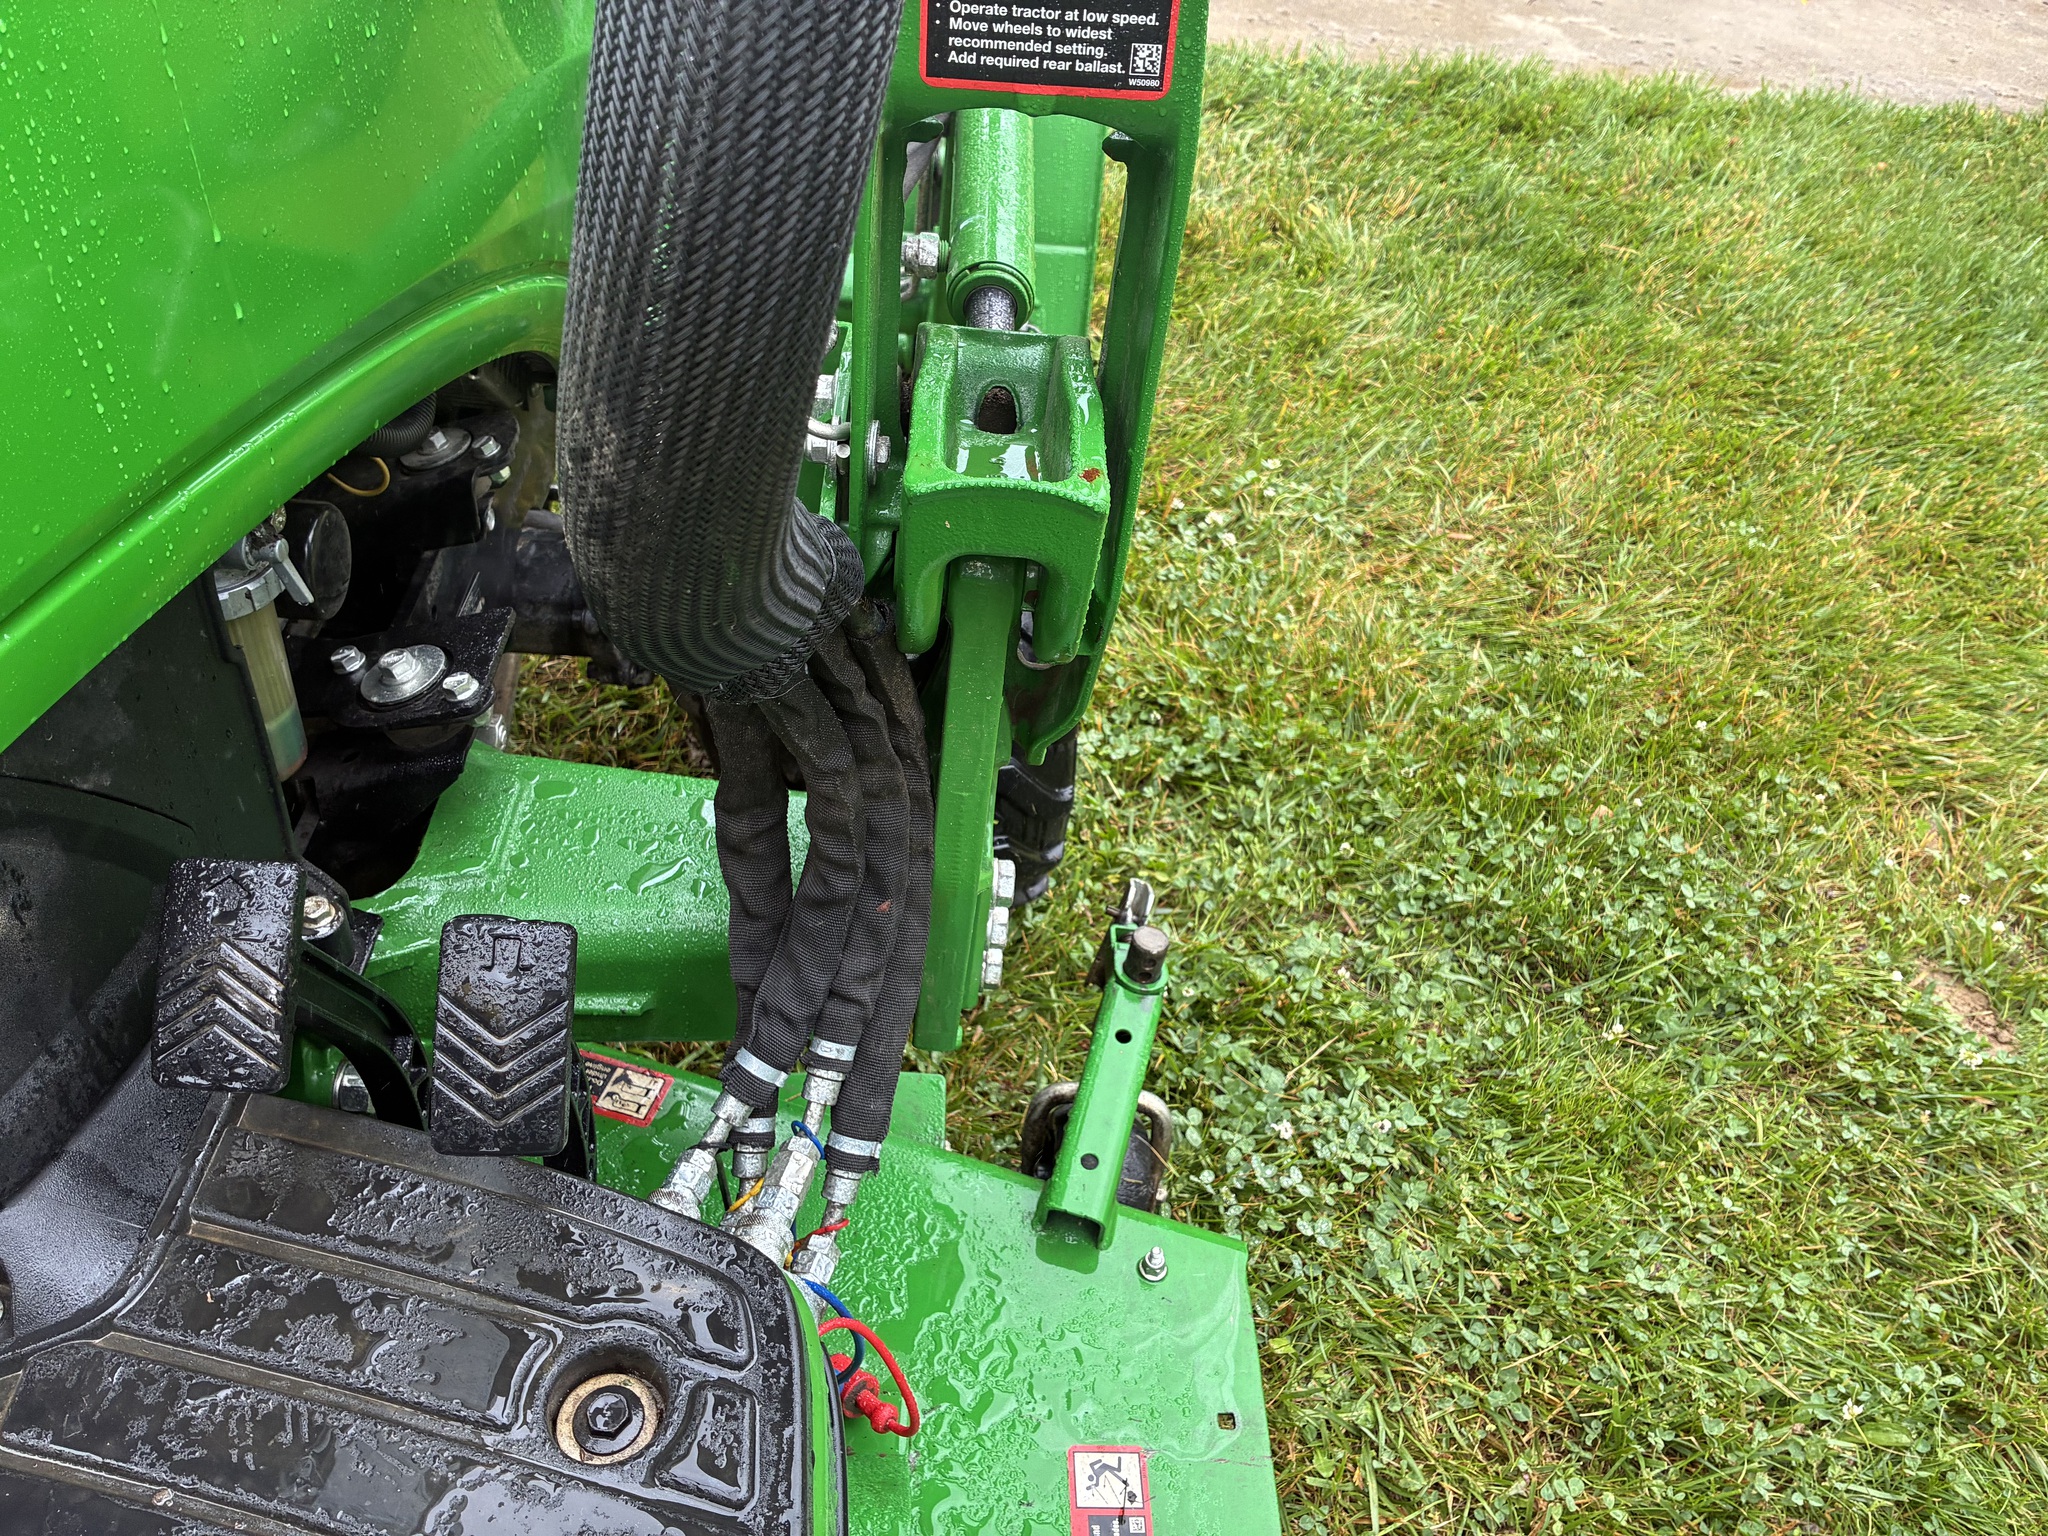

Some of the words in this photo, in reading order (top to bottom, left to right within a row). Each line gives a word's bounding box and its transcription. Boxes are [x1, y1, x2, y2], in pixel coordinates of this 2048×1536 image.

[949, 0, 1008, 16] Operate
[1012, 5, 1061, 20] tractor
[1064, 9, 1080, 21] at
[1082, 9, 1109, 23] low
[1112, 13, 1160, 26] speed.
[949, 17, 989, 31] Move
[992, 21, 1043, 36] wheels
[1046, 25, 1061, 37] to
[1065, 26, 1113, 40] widest
[948, 36, 1052, 53] recommended
[1055, 43, 1108, 58] setting.
[947, 50, 977, 64] Add
[980, 55, 1040, 69] required
[1043, 59, 1072, 71] rear
[1075, 59, 1126, 74] ballast.
[1128, 78, 1160, 87] W50980
